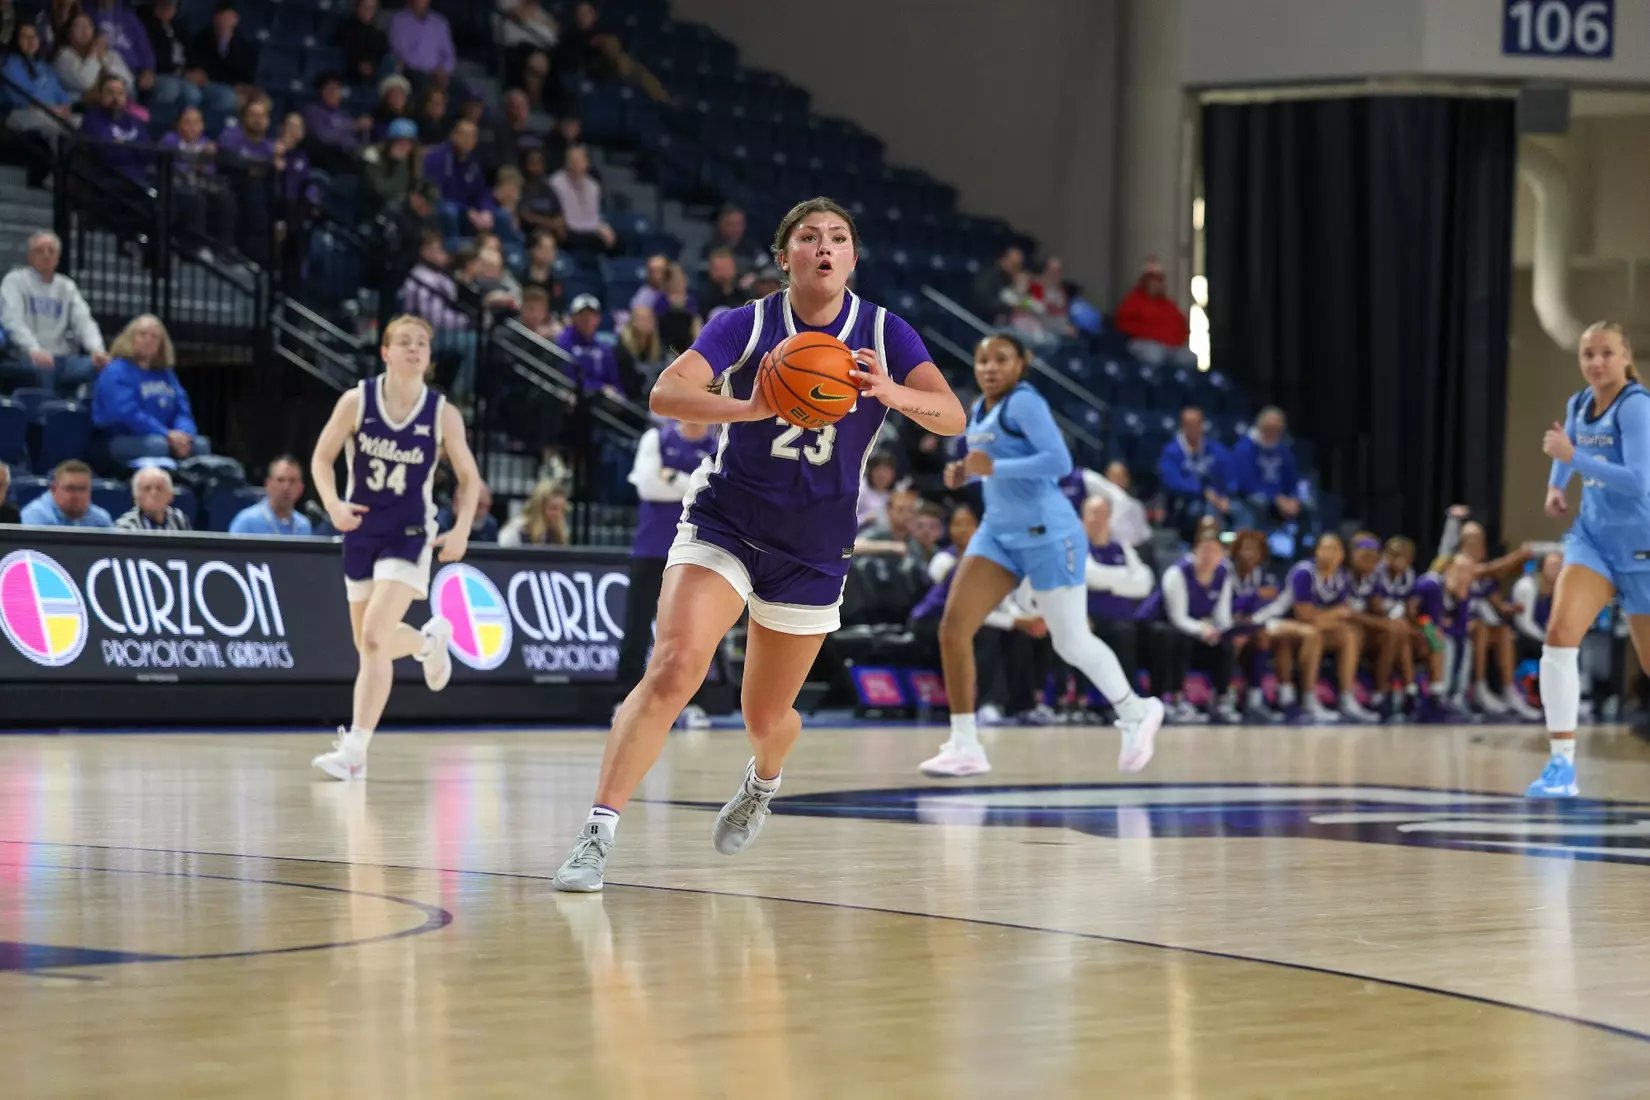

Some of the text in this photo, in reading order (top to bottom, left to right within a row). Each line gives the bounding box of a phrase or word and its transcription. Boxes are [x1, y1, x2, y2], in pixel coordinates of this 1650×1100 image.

[1509, 0, 1609, 53] 106
[770, 419, 837, 466] 23
[366, 459, 407, 496] 34
[86, 558, 286, 637] CURZON
[507, 571, 631, 642] CURZO
